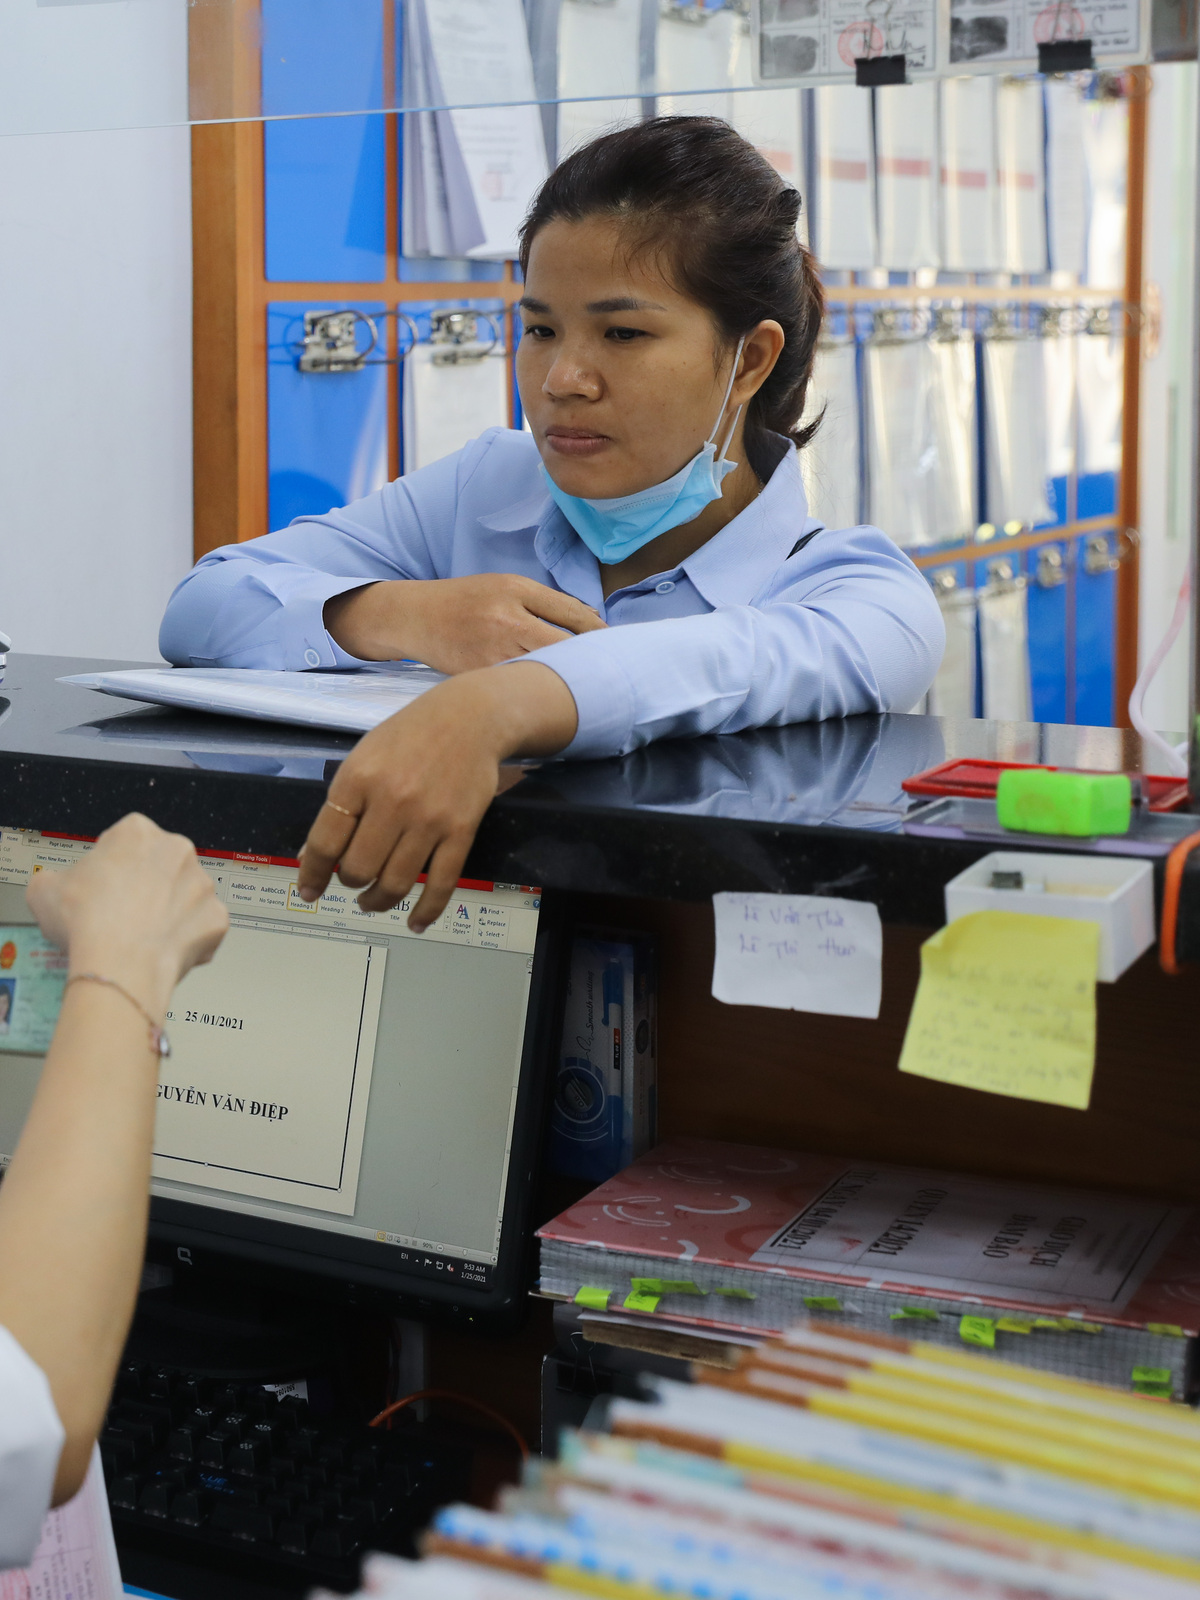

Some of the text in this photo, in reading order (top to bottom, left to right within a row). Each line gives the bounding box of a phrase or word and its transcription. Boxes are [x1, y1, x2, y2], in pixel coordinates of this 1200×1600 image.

[290, 901, 309, 909] Heading
[321, 905, 340, 913] Heading
[352, 910, 371, 918] Heading
[585, 1001, 594, 1028] Smooth
[185, 1011, 244, 1030] 25 /01/2021
[156, 1084, 288, 1122] GUYỄN VĂN ĐIỆP
[868, 1218, 924, 1256] 14/2021
[1029, 1216, 1088, 1268] GIAO DỊCH
[401, 1252, 408, 1260] EN
[464, 1263, 475, 1271] 9:53
[461, 1272, 486, 1282] 1/25/2021
